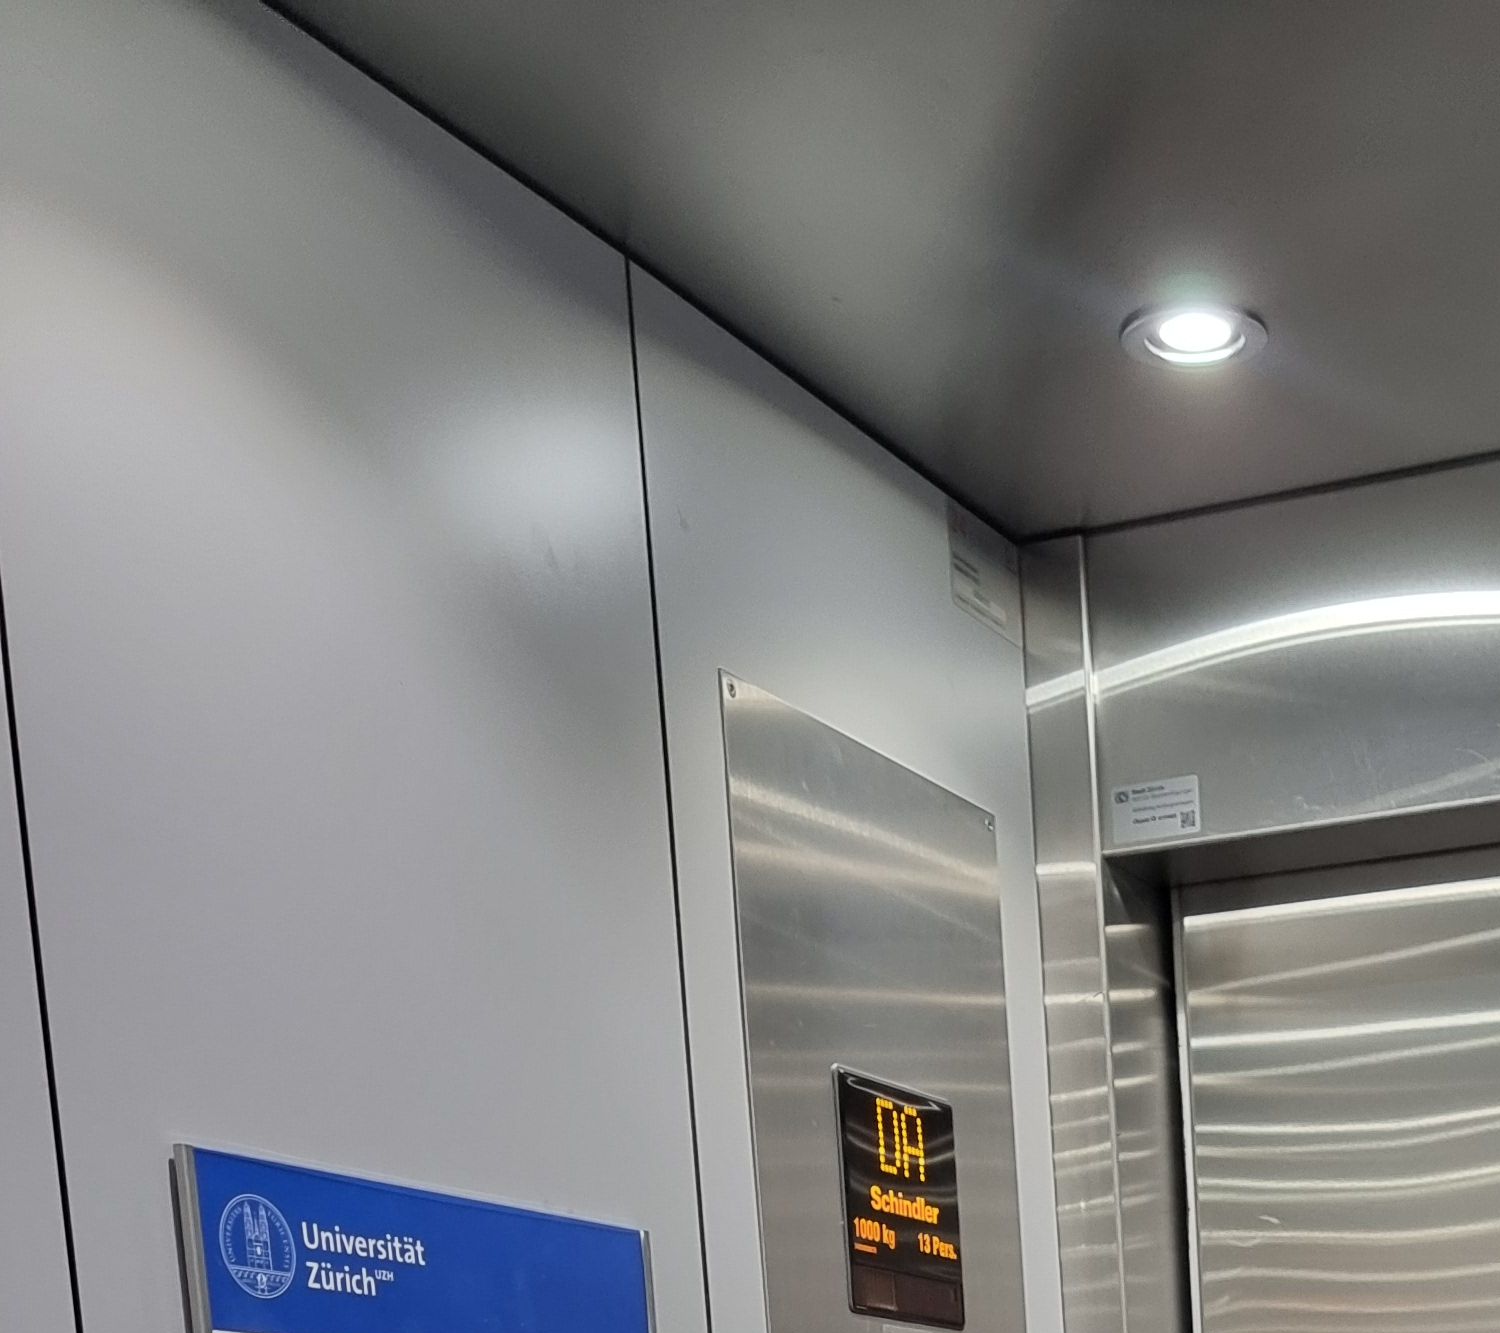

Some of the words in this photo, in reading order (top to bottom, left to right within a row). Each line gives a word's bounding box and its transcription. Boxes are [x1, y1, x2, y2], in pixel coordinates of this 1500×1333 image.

[876, 1097, 925, 1182] DA
[870, 1185, 939, 1224] Schindler
[301, 1221, 426, 1266] Universität
[854, 1216, 881, 1242] 1000
[882, 1224, 895, 1249] kg
[918, 1233, 930, 1254] 13
[933, 1236, 957, 1259] Pers.
[305, 1261, 376, 1296] Zürich
[375, 1269, 394, 1281] UZH
